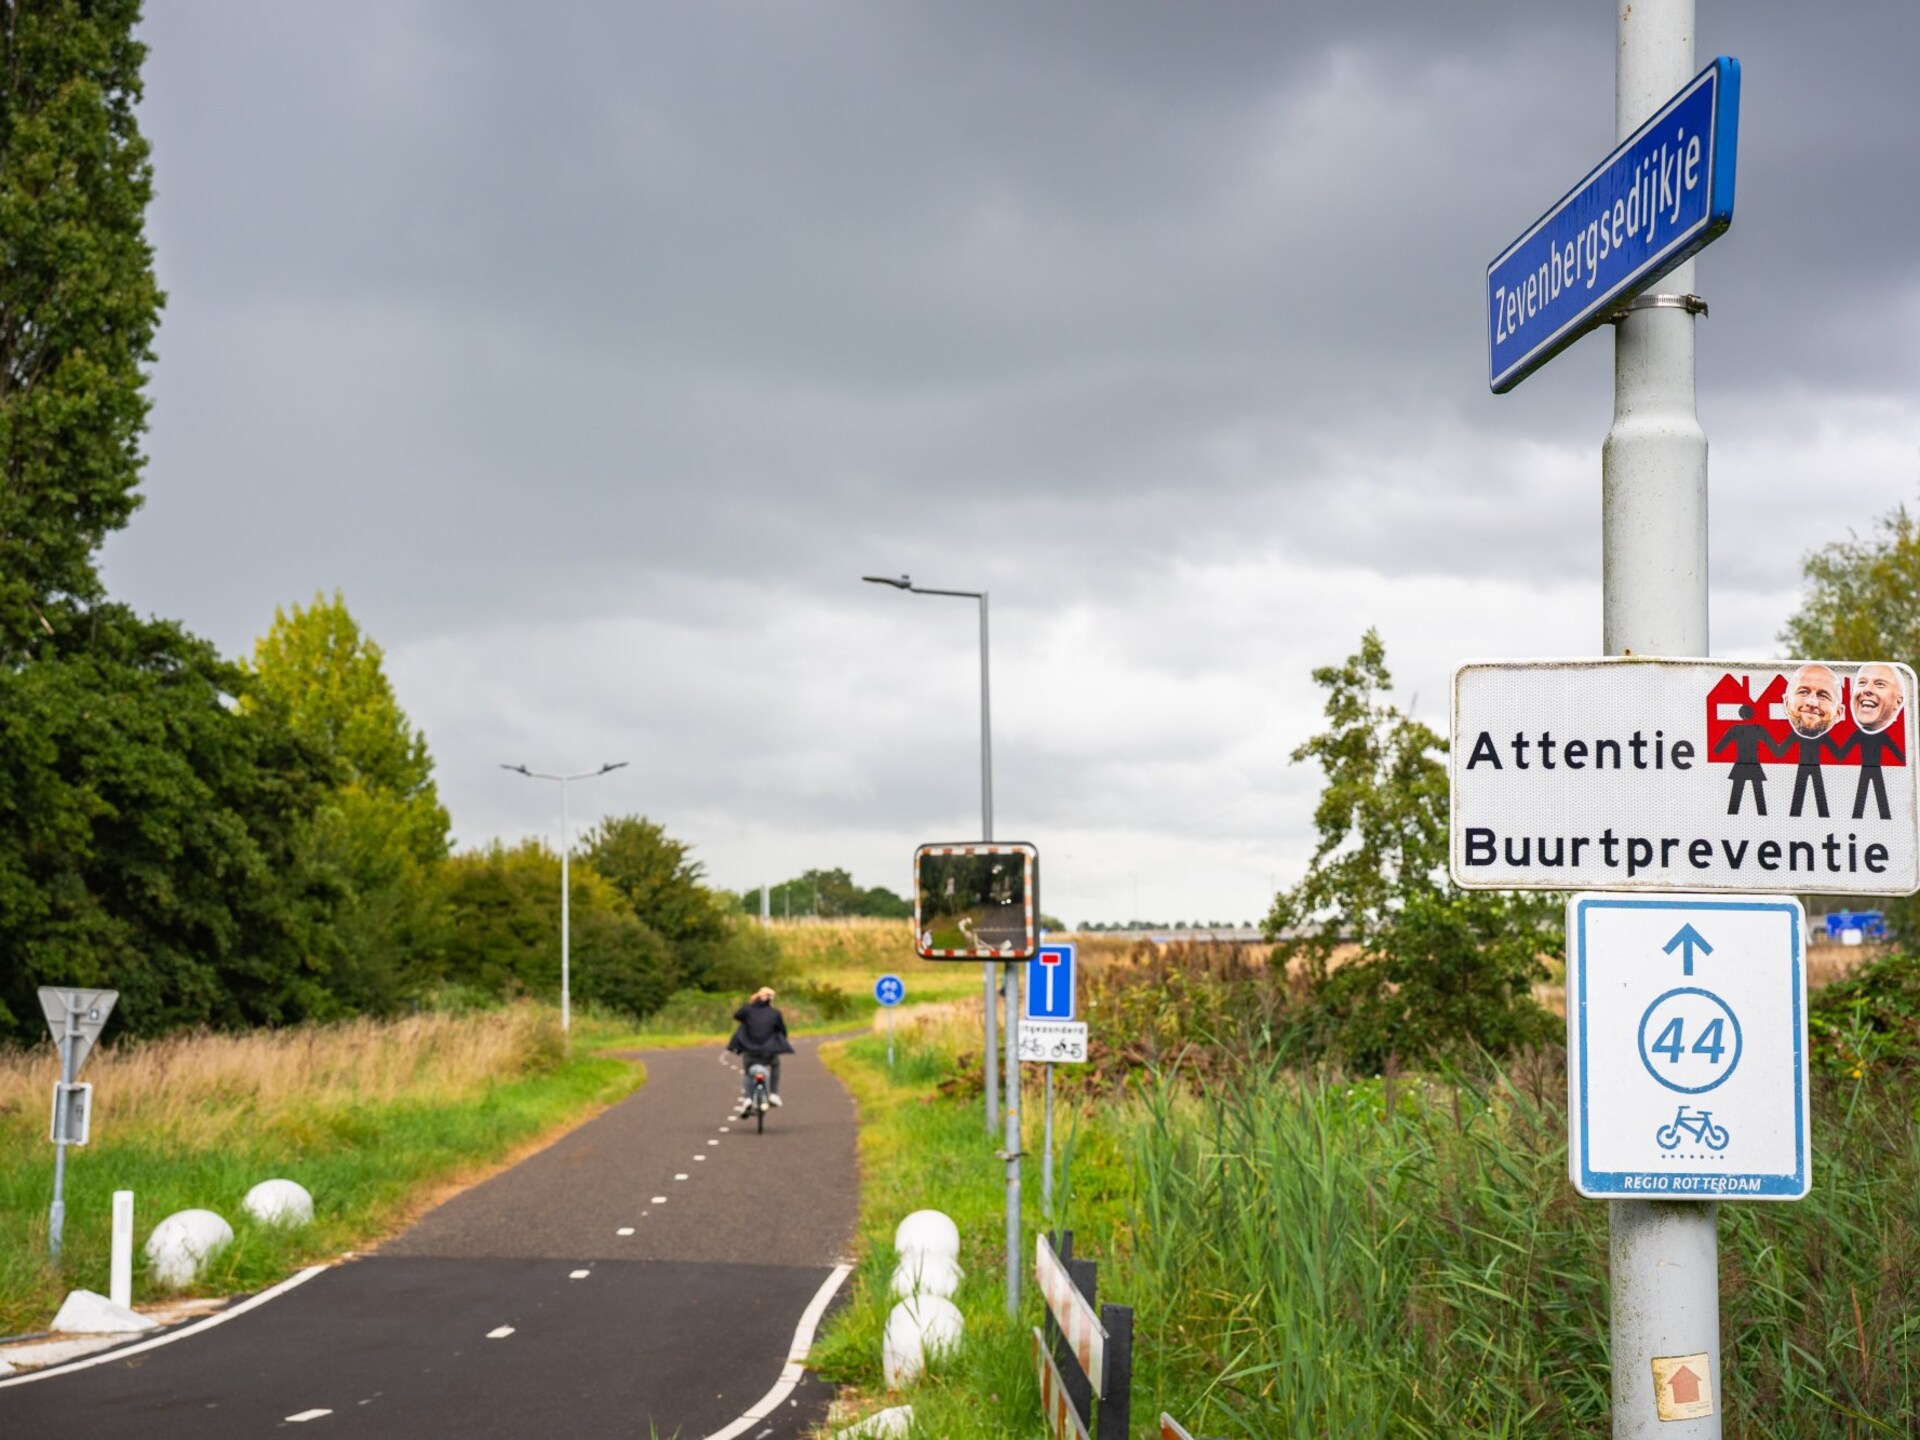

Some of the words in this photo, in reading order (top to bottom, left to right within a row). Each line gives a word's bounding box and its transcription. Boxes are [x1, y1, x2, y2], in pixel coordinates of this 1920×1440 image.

[1496, 127, 1700, 345] Zevenbergsedijkje
[1466, 730, 1695, 770] Attentie
[1465, 827, 1890, 876] Buurtpreventie
[1652, 1017, 1725, 1064] 44
[1624, 1176, 1668, 1189] REGIO
[1672, 1177, 1762, 1191] ROTTERDAM
